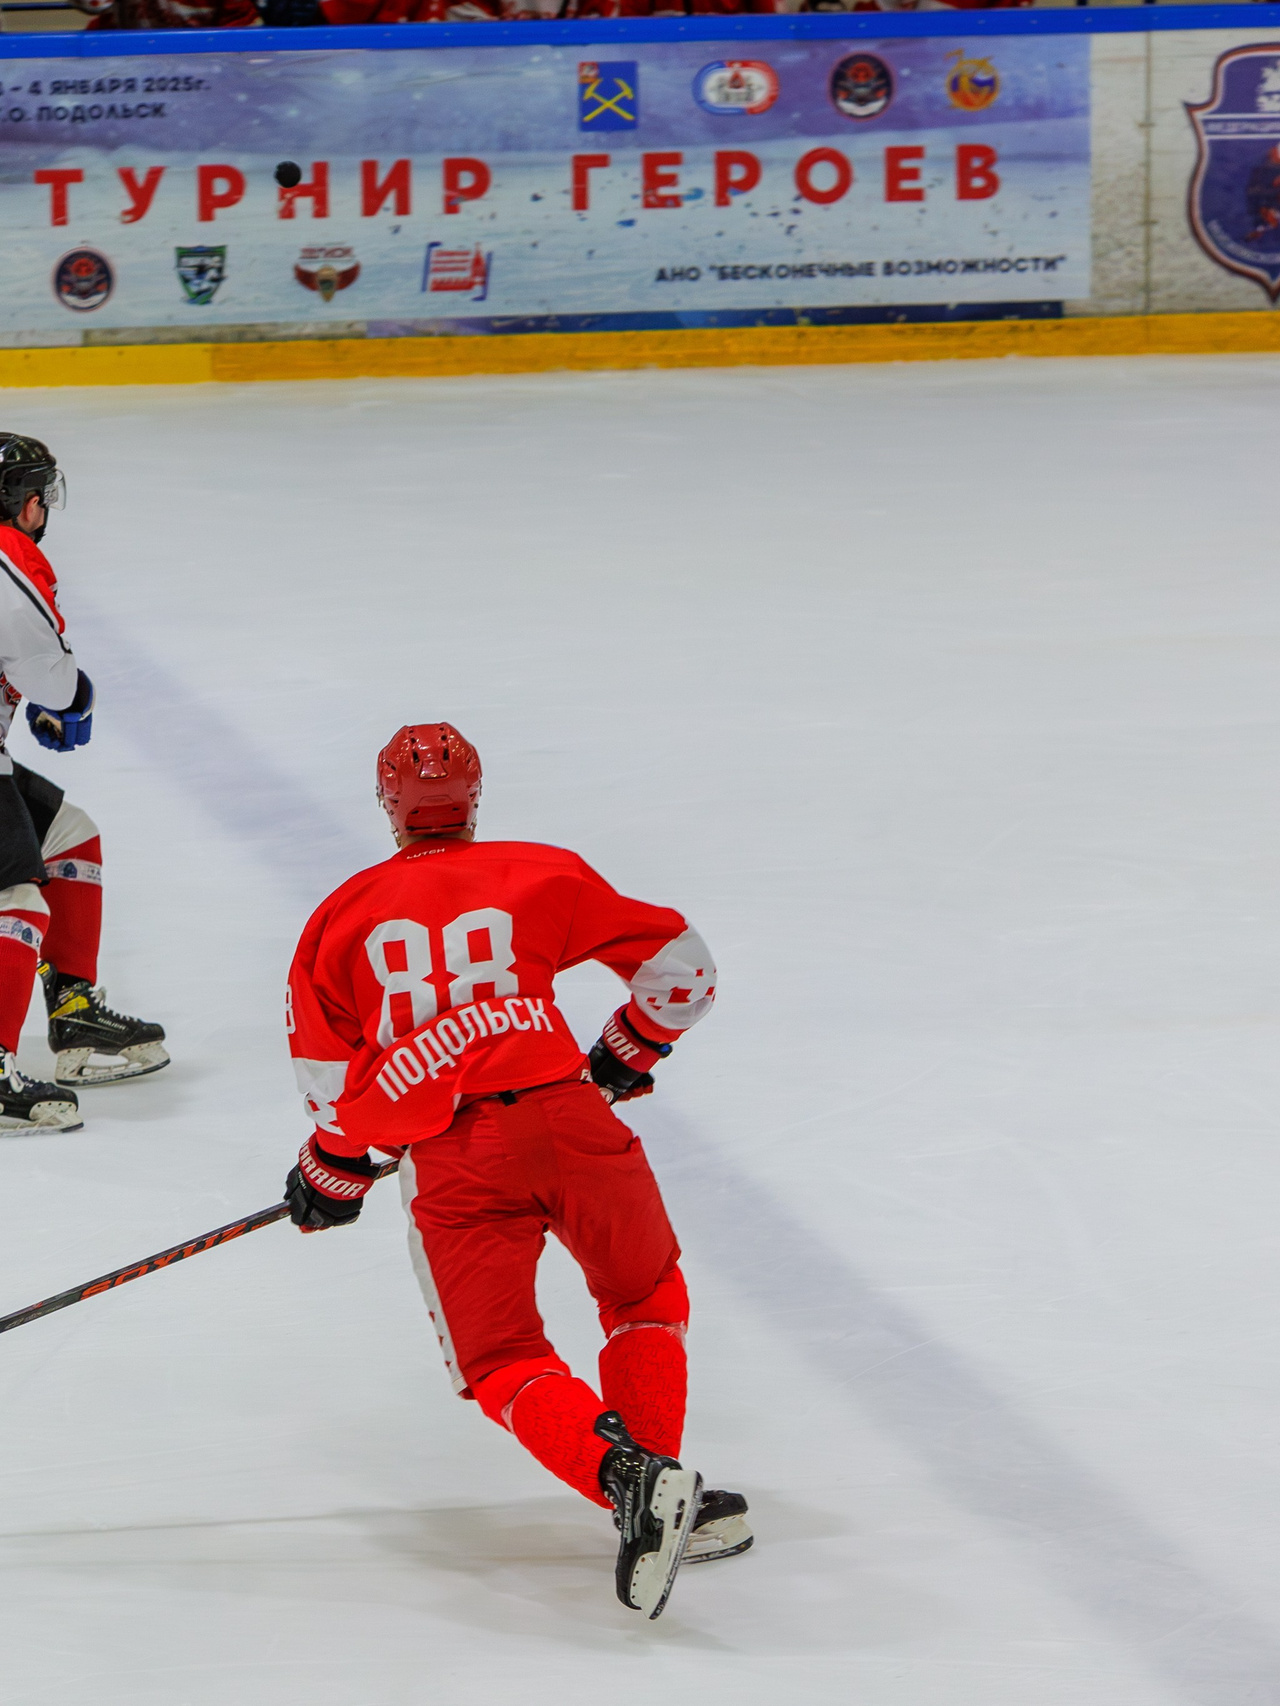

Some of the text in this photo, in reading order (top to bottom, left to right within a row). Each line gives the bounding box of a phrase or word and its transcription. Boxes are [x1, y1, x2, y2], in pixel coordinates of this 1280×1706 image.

[28, 80, 42, 95] 4
[50, 77, 139, 95] ЯНВАРЯ
[37, 103, 167, 123] ПОДОЛЬСК
[34, 157, 492, 227] ТУРНИР
[572, 143, 1000, 211] ГЕРОЕВ
[655, 267, 701, 283] АНО
[364, 906, 519, 1050] 88
[376, 998, 554, 1102] ПОДОЛЬСК
[299, 1139, 366, 1197] ARRIOR
